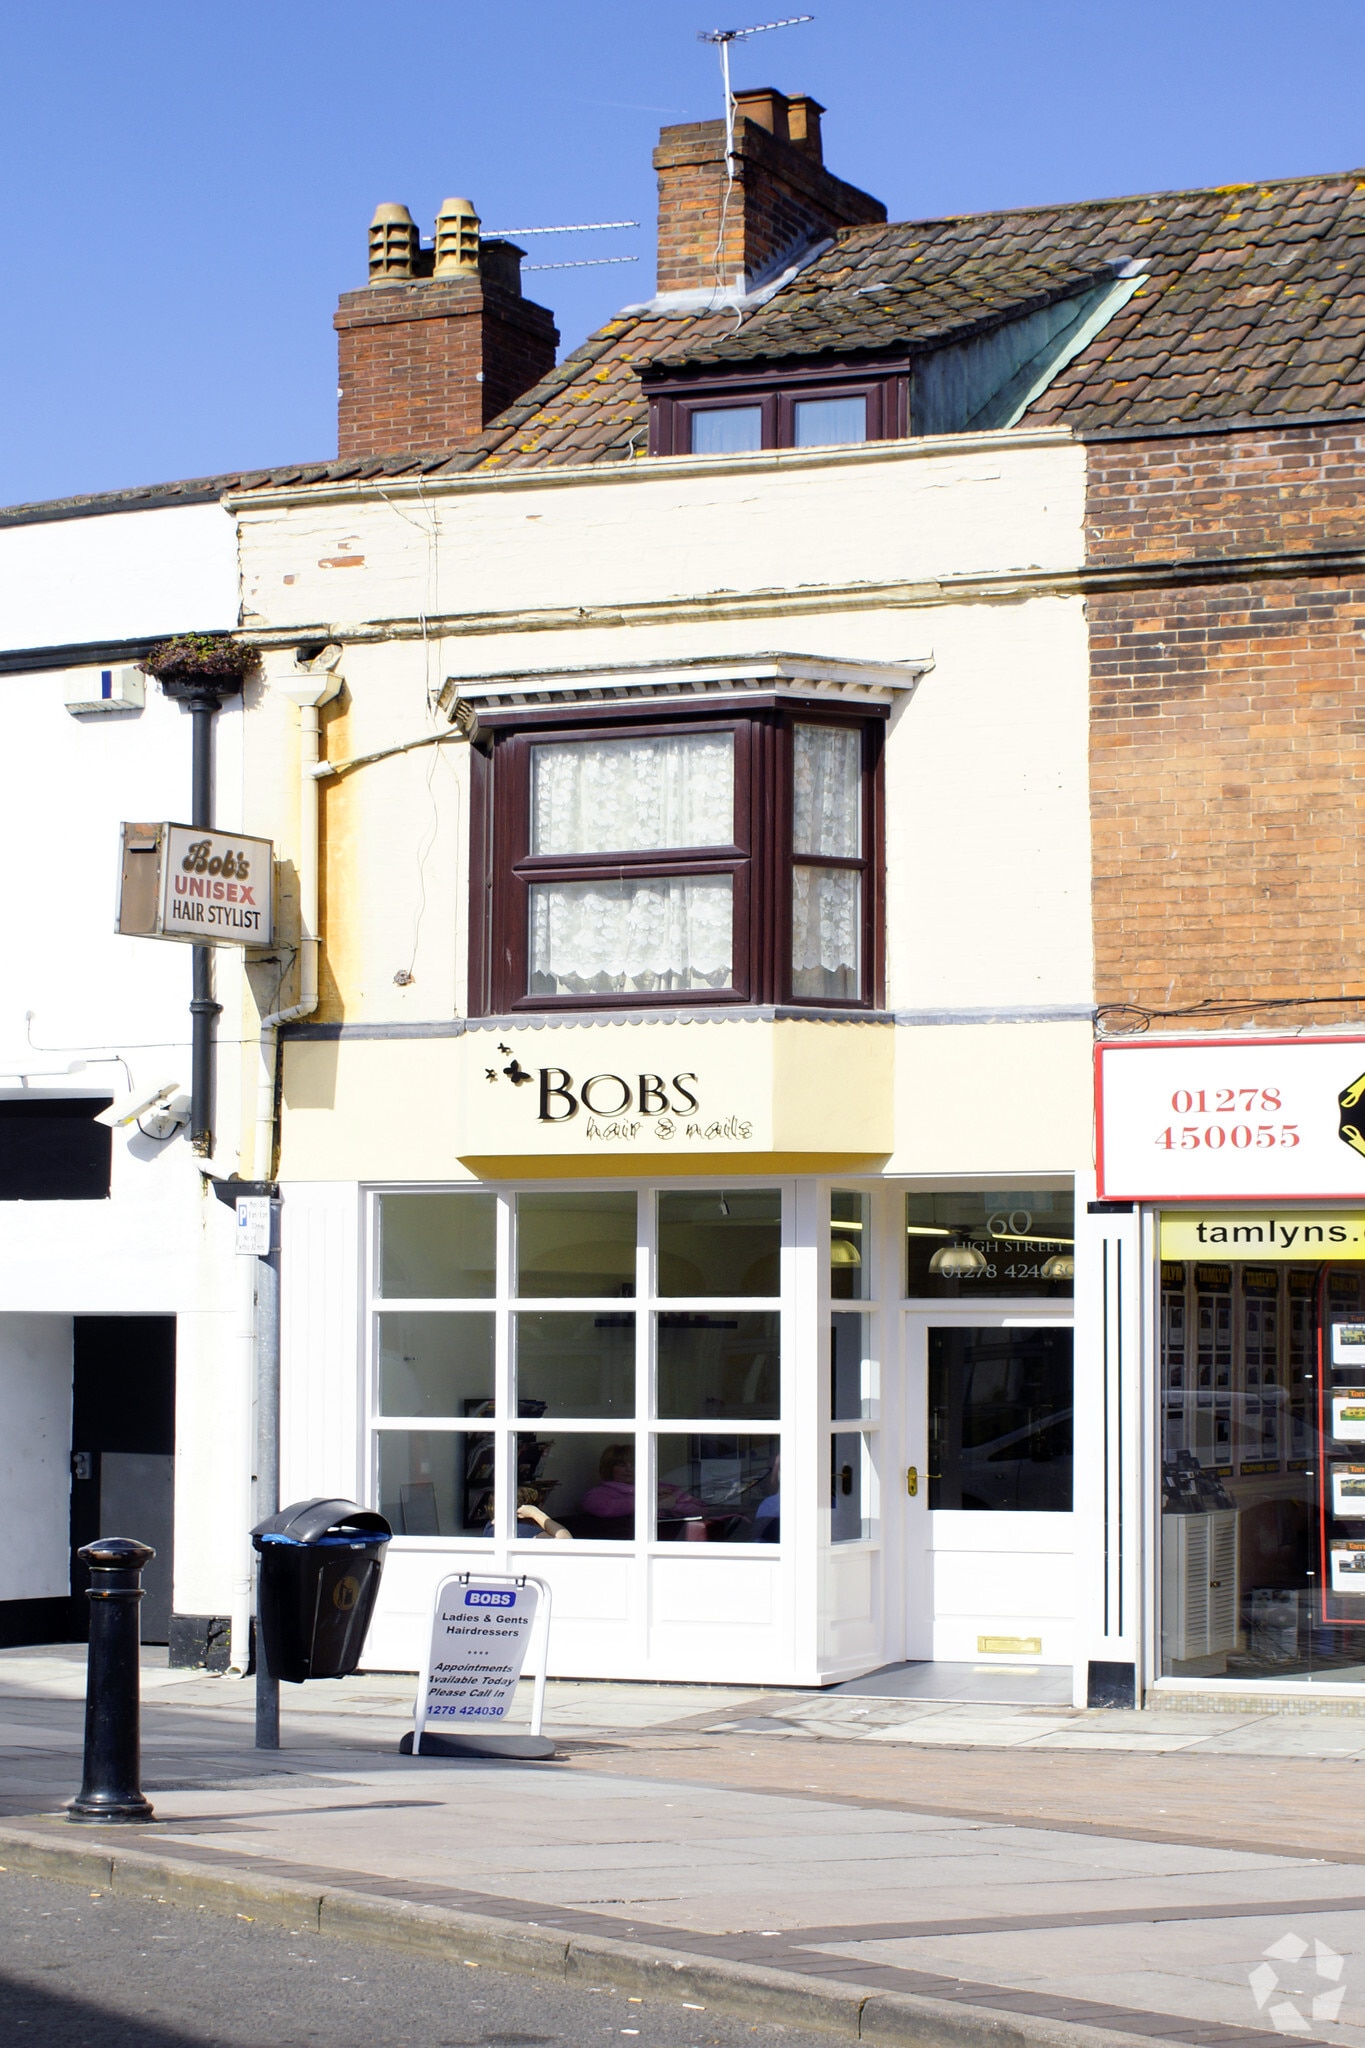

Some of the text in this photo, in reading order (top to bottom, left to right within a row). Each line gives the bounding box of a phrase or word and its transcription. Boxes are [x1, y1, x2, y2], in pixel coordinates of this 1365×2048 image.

[182, 839, 250, 881] Bob's
[174, 874, 256, 906] UNISEX
[172, 899, 261, 930] HAIR STYLIST
[536, 1067, 699, 1122] BOBS
[1171, 1087, 1282, 1114] 01278
[586, 1116, 643, 1141] hair
[685, 1115, 753, 1141] nails
[1154, 1124, 1301, 1150] 450055
[986, 1209, 1033, 1236] 60
[1196, 1220, 1365, 1249] tamlyns.
[953, 1240, 1066, 1253] HIGH STREET
[942, 1263, 1075, 1279] 01278 424030
[469, 1593, 511, 1606] BOBS
[442, 1612, 529, 1625] Ladies & Gents
[446, 1626, 519, 1637] Hairdressers
[434, 1662, 514, 1673] Appointments
[428, 1687, 505, 1697] Please Call In
[482, 1676, 515, 1687] Today
[426, 1705, 504, 1716] 1278 424030
